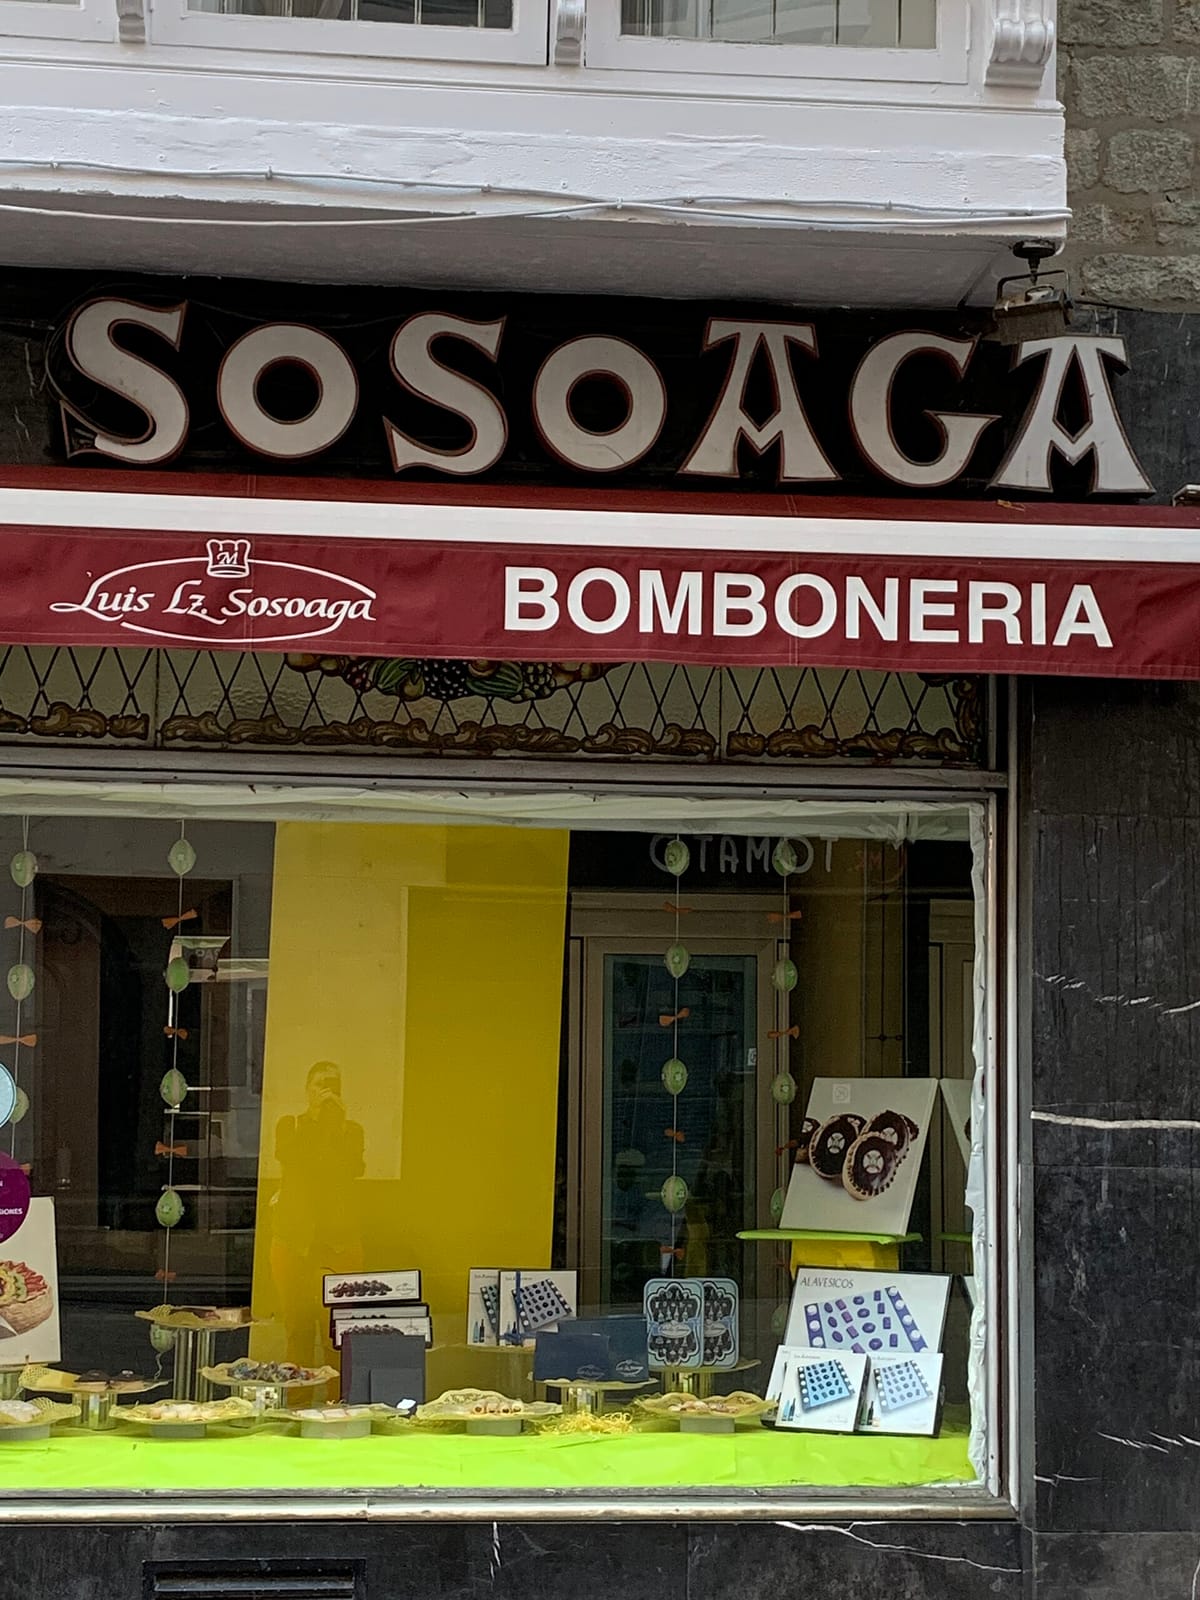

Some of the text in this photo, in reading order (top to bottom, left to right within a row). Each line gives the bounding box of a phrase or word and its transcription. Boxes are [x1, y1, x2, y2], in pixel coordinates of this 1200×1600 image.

[60, 296, 1156, 494] SOSOAGA
[49, 572, 156, 622] Luis
[220, 589, 377, 633] Sosoaga
[503, 565, 1113, 650] BOMBONERIA
[800, 1276, 855, 1289] ALAVESICOS
